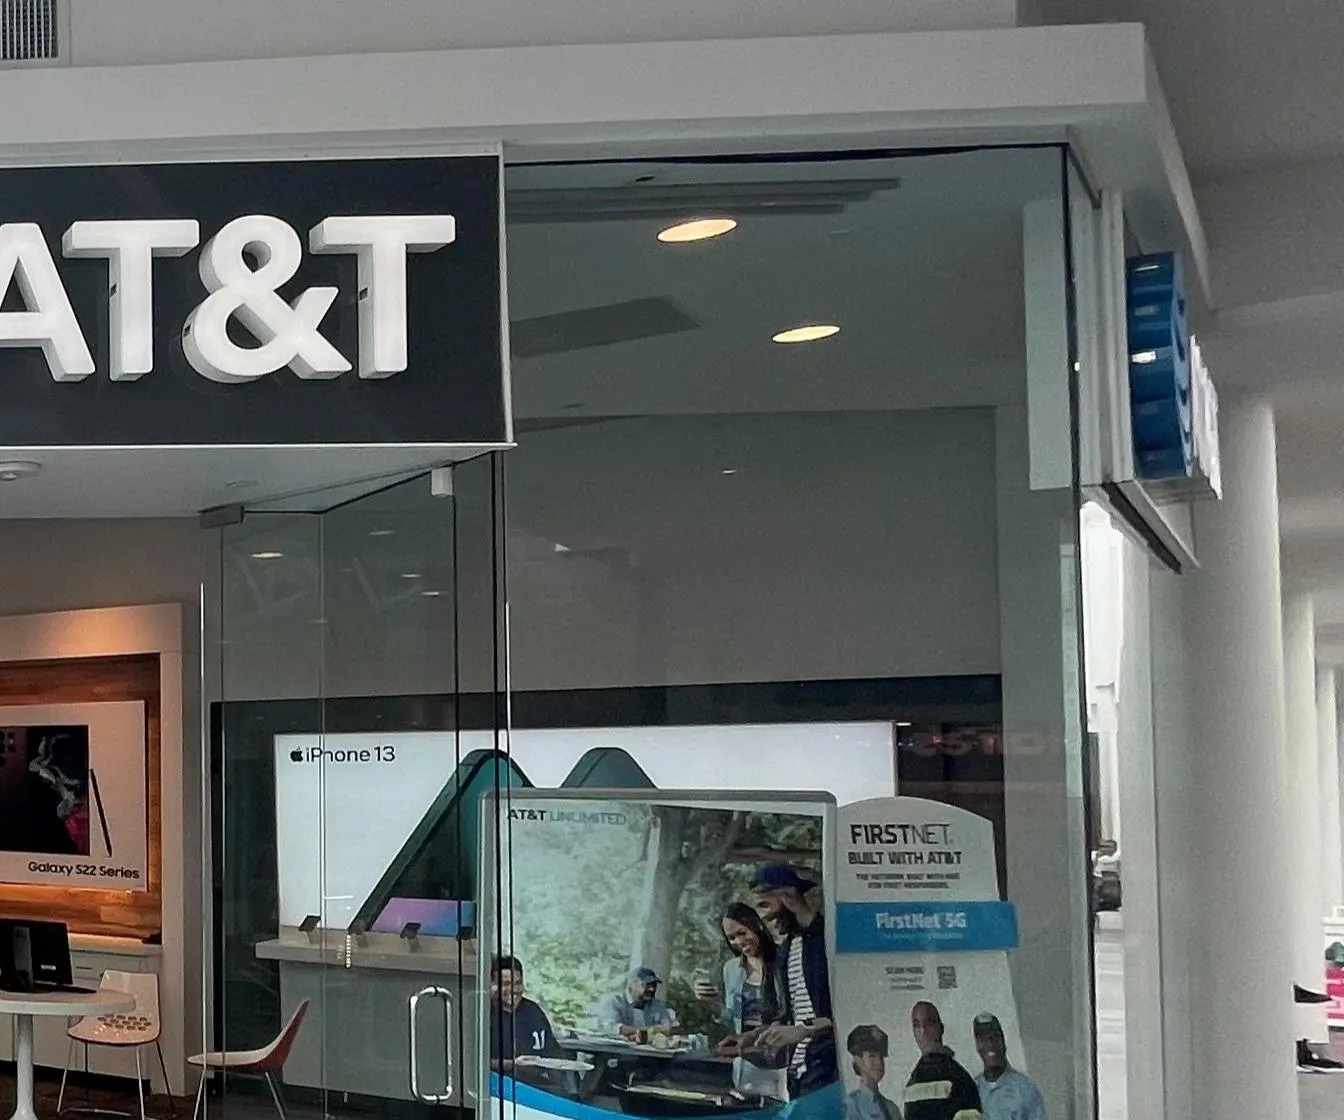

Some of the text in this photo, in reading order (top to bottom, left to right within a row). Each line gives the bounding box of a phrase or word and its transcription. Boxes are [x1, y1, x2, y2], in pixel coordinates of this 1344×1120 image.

[306, 746, 396, 762] iPhone 13
[508, 809, 627, 826] AT&T UNLIMITED
[848, 851, 962, 865] BUILT WITH AT&T
[28, 861, 140, 879] Galaxy S22 Series
[945, 912, 968, 928] 5G
